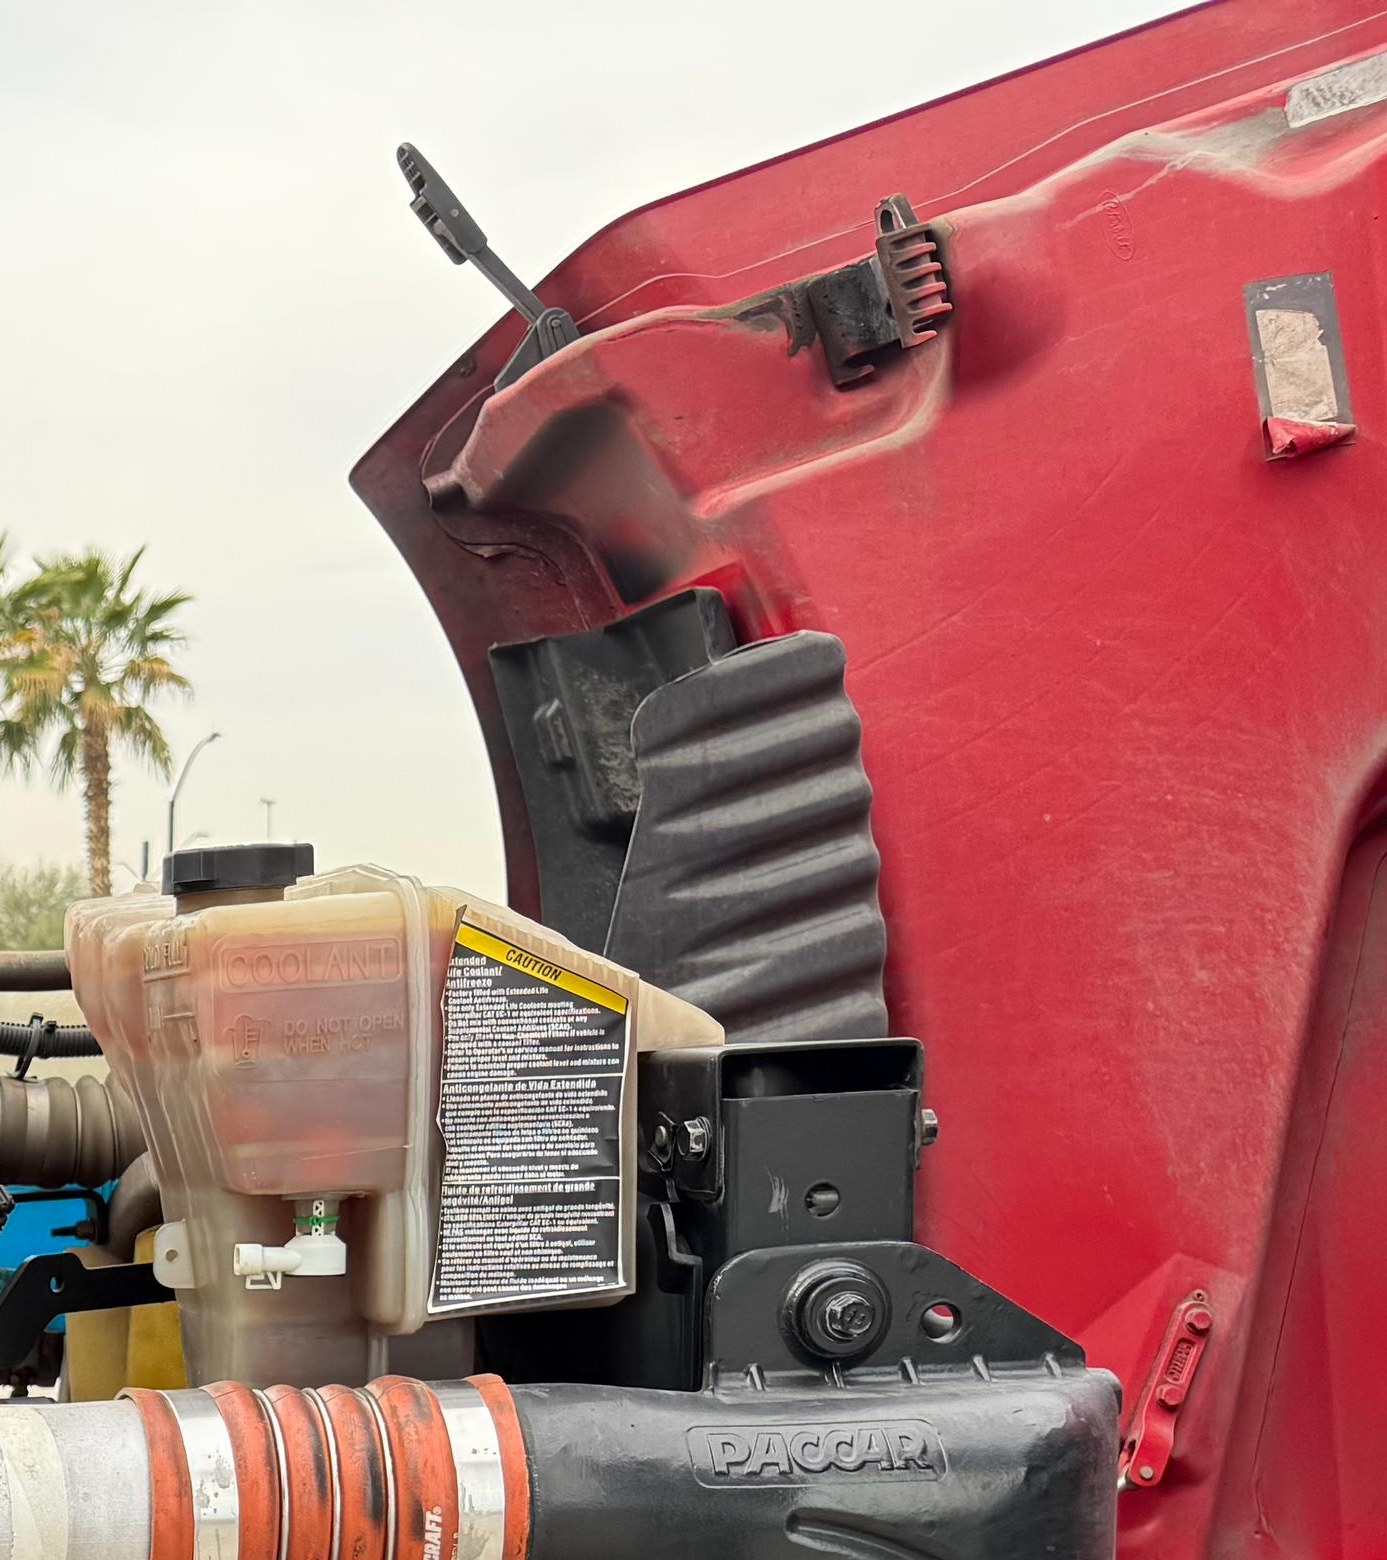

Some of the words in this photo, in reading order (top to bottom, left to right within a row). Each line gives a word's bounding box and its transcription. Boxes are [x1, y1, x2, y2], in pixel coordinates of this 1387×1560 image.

[227, 944, 395, 987] COOLANT
[450, 957, 487, 966] xtended
[506, 949, 563, 982] CAUTION
[317, 1017, 350, 1034] NOT
[359, 1013, 404, 1031] OPEN
[706, 1427, 933, 1476] PACCAR
